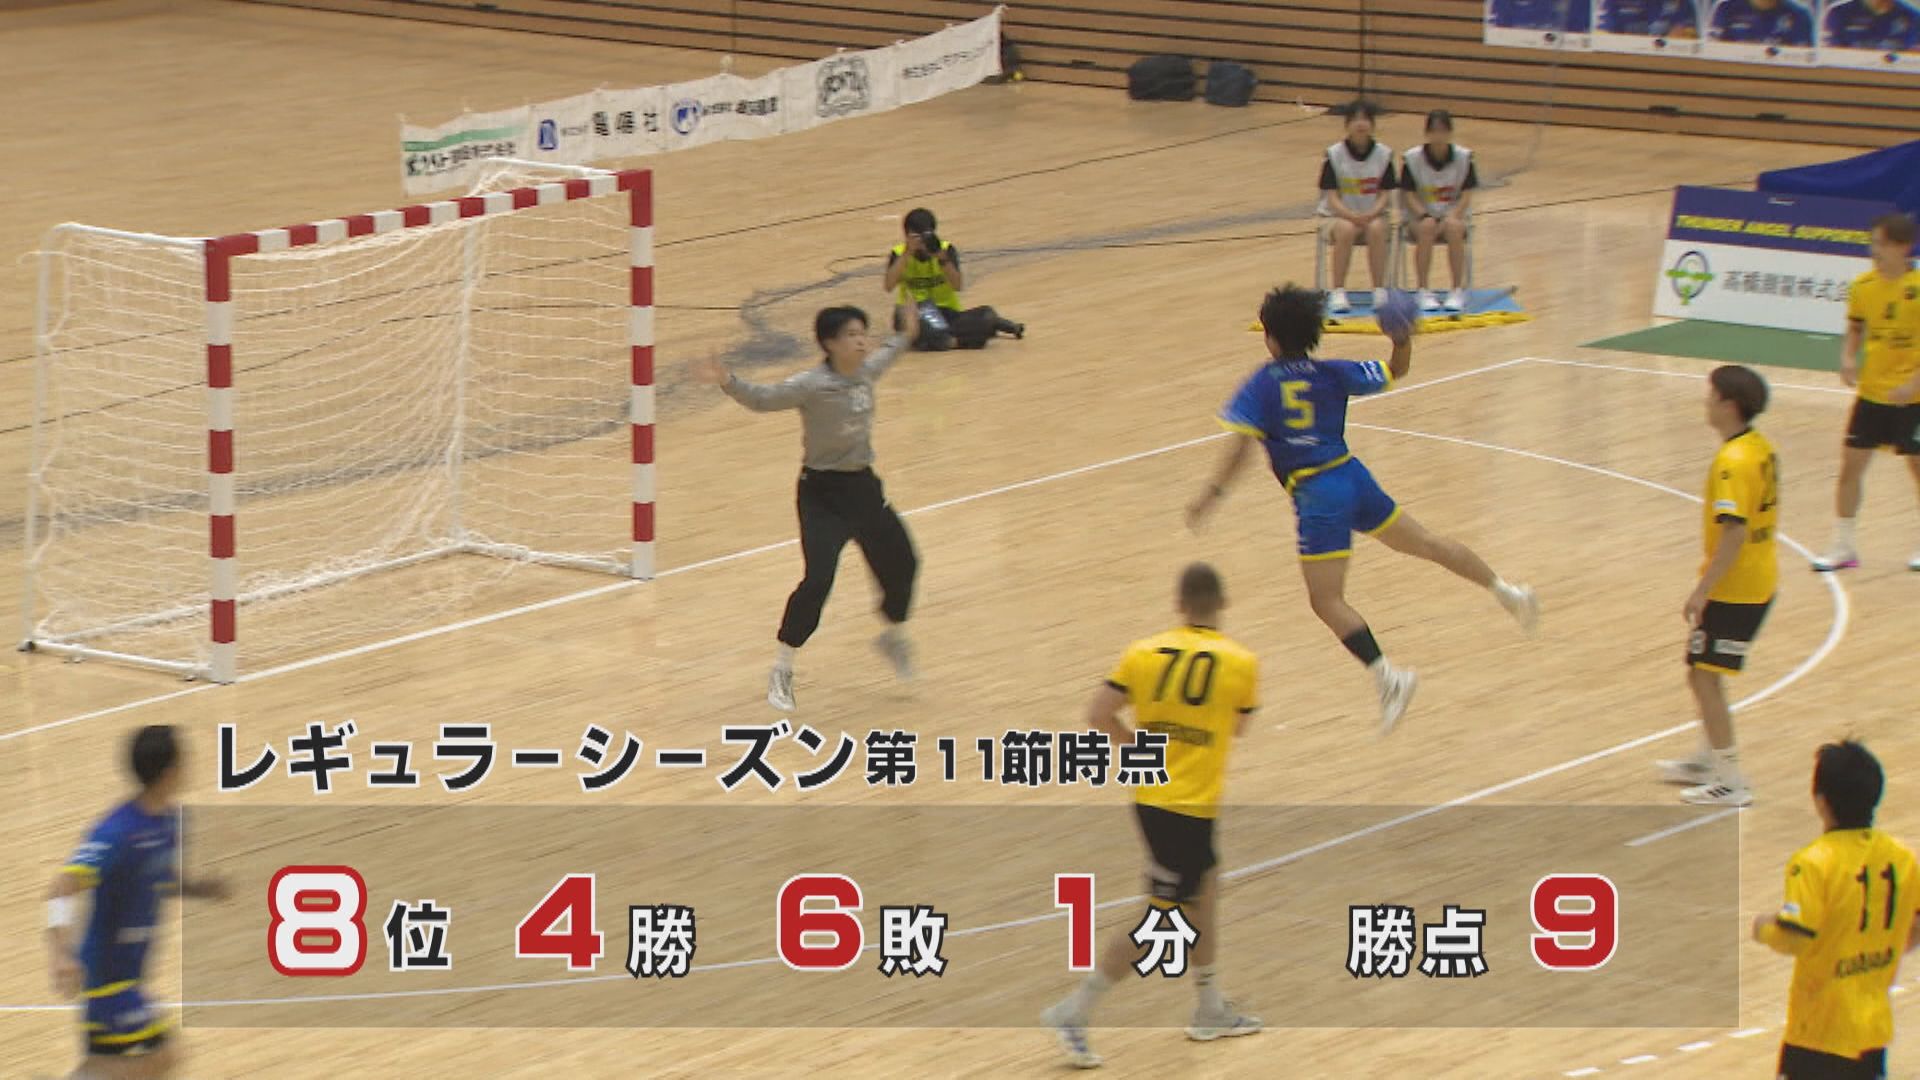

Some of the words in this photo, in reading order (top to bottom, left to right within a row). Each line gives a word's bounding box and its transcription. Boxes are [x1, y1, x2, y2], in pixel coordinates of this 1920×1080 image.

[1279, 379, 1316, 430] 5
[1154, 646, 1218, 706] 70
[1855, 862, 1897, 933] 11
